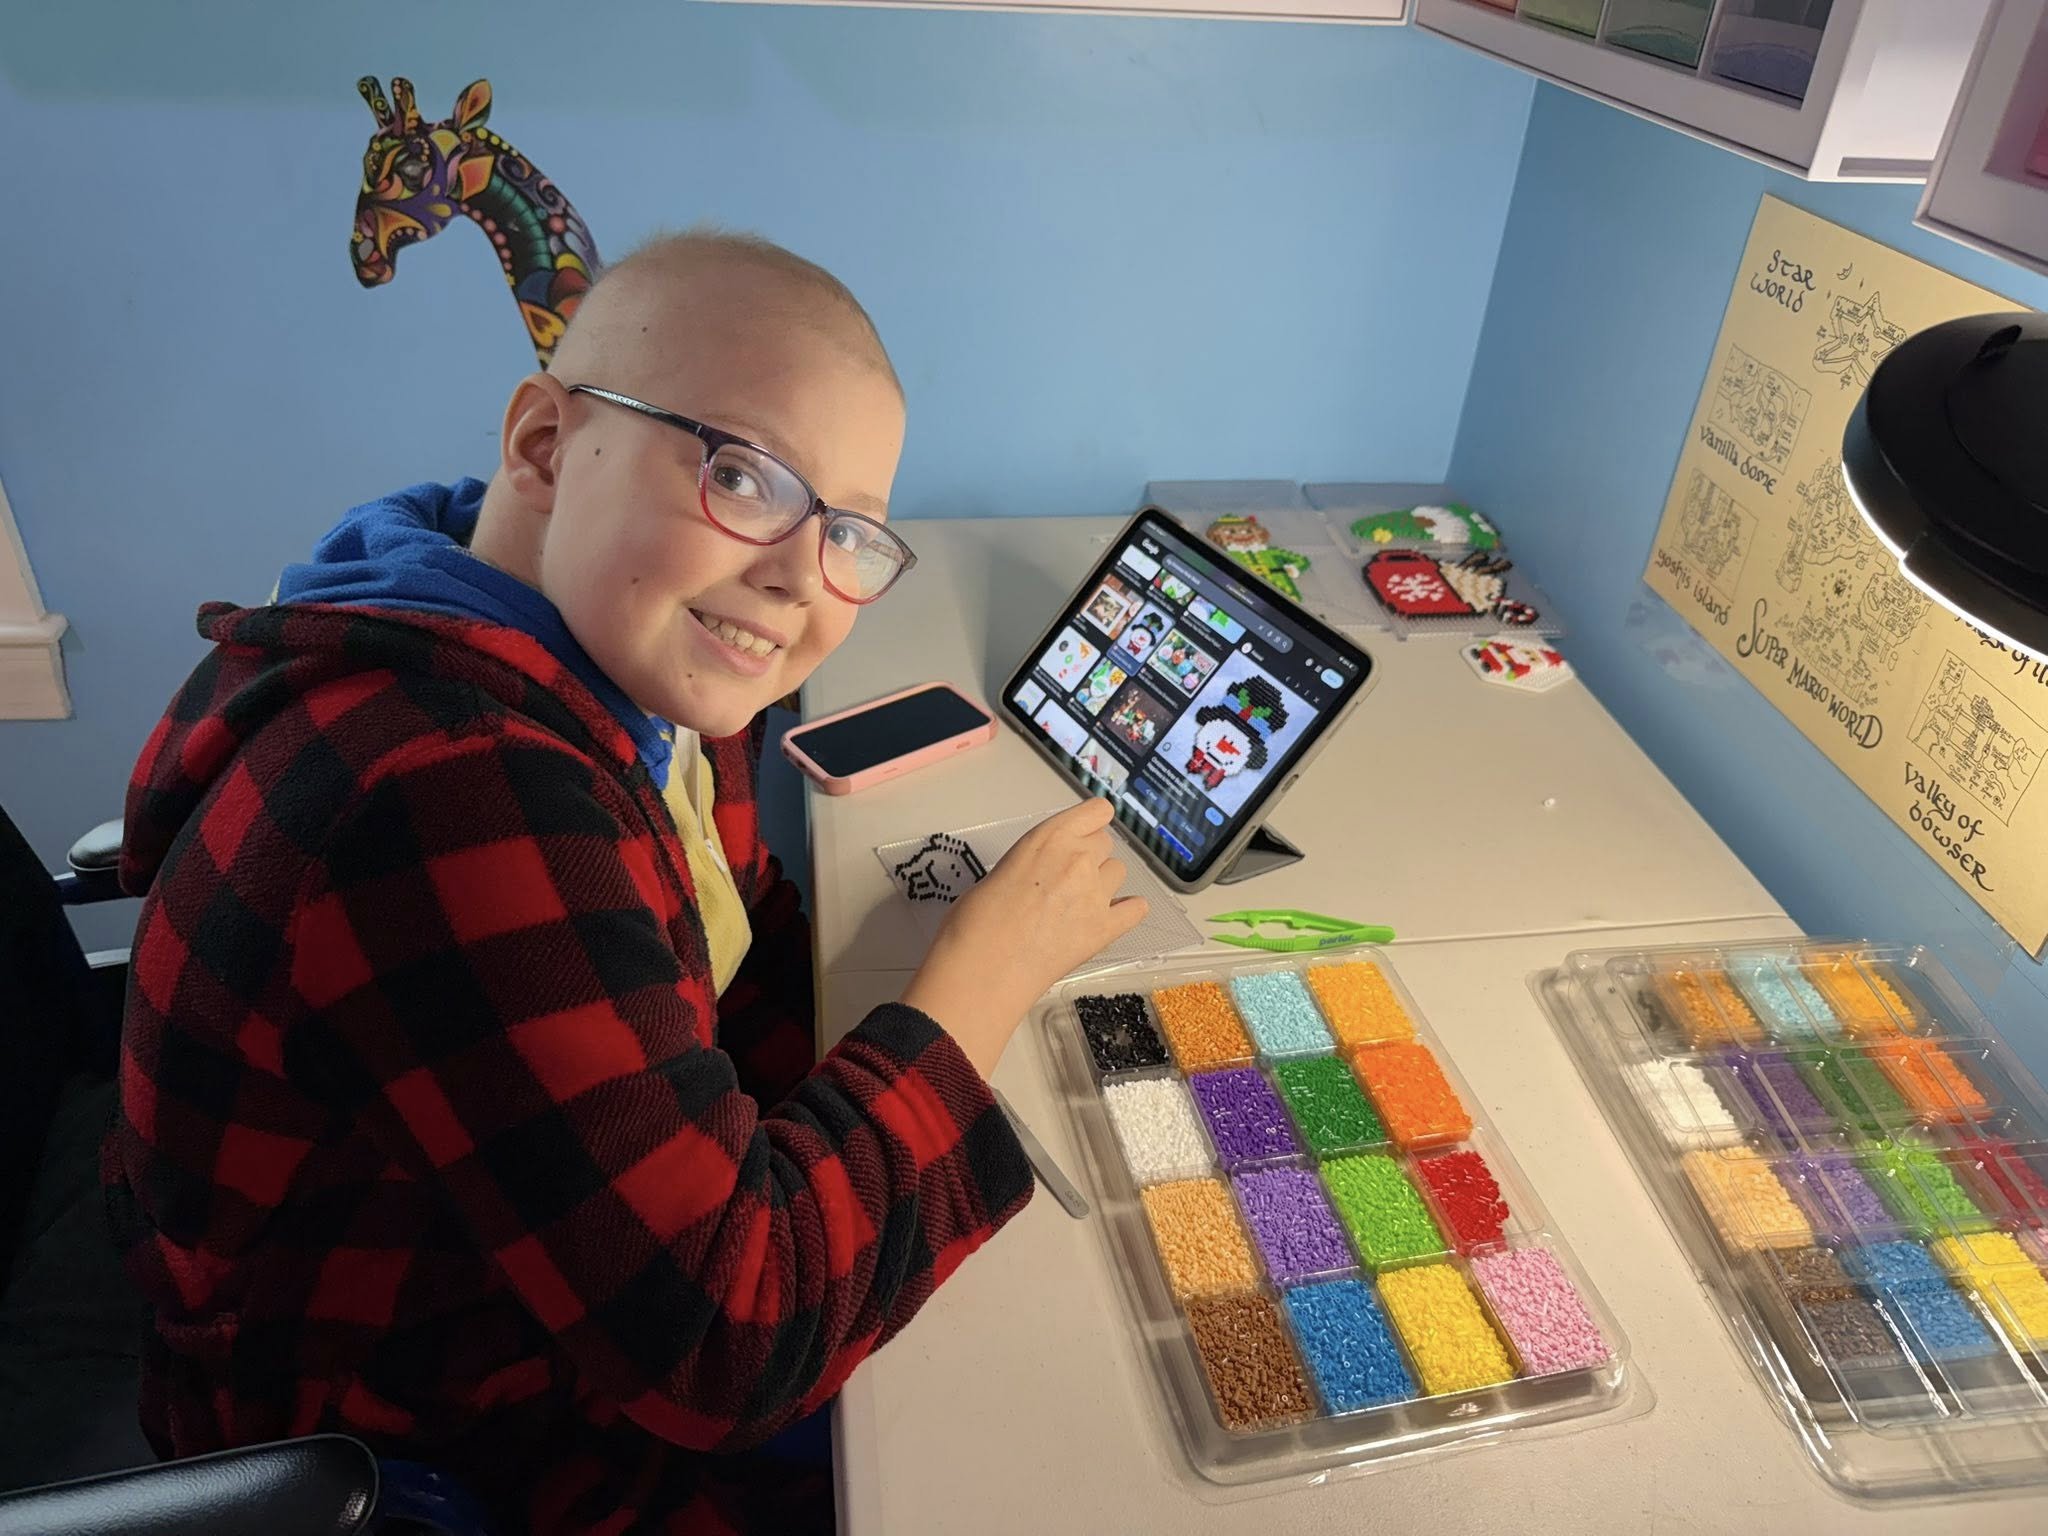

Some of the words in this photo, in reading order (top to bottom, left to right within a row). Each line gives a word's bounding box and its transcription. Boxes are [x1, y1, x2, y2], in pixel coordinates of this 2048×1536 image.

[1736, 597, 1789, 670] SUPER
[1785, 659, 1829, 708] MARIO
[1826, 693, 1884, 750] WORLD
[1957, 813, 1985, 843] of
